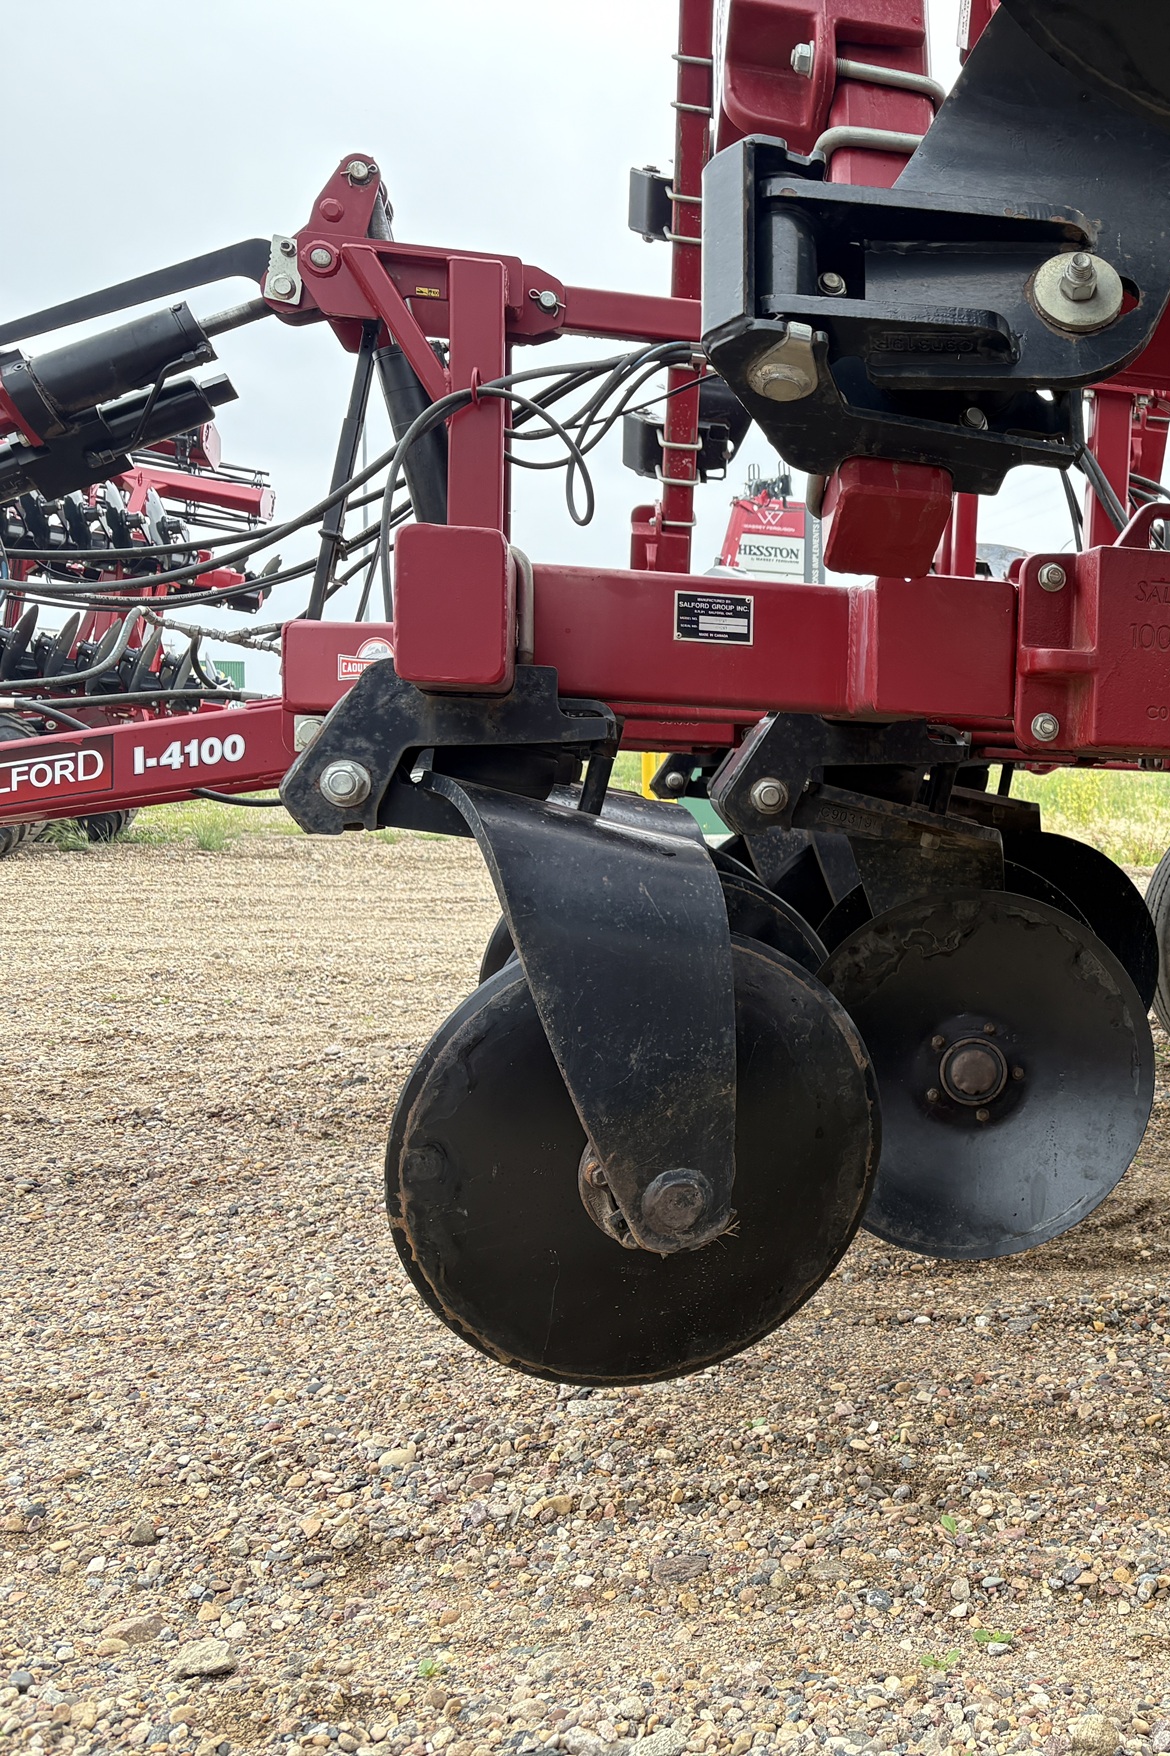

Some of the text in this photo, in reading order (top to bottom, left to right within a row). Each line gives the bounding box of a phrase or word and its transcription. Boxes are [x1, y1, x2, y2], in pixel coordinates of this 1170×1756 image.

[738, 544, 800, 560] HESSTON
[812, 524, 820, 568] IMPLEMENTS
[679, 601, 710, 609] SALFORD
[712, 603, 735, 611] GROUP
[133, 733, 246, 775] I-4100
[0, 749, 105, 794] FORD
[820, 806, 878, 831] C90319
